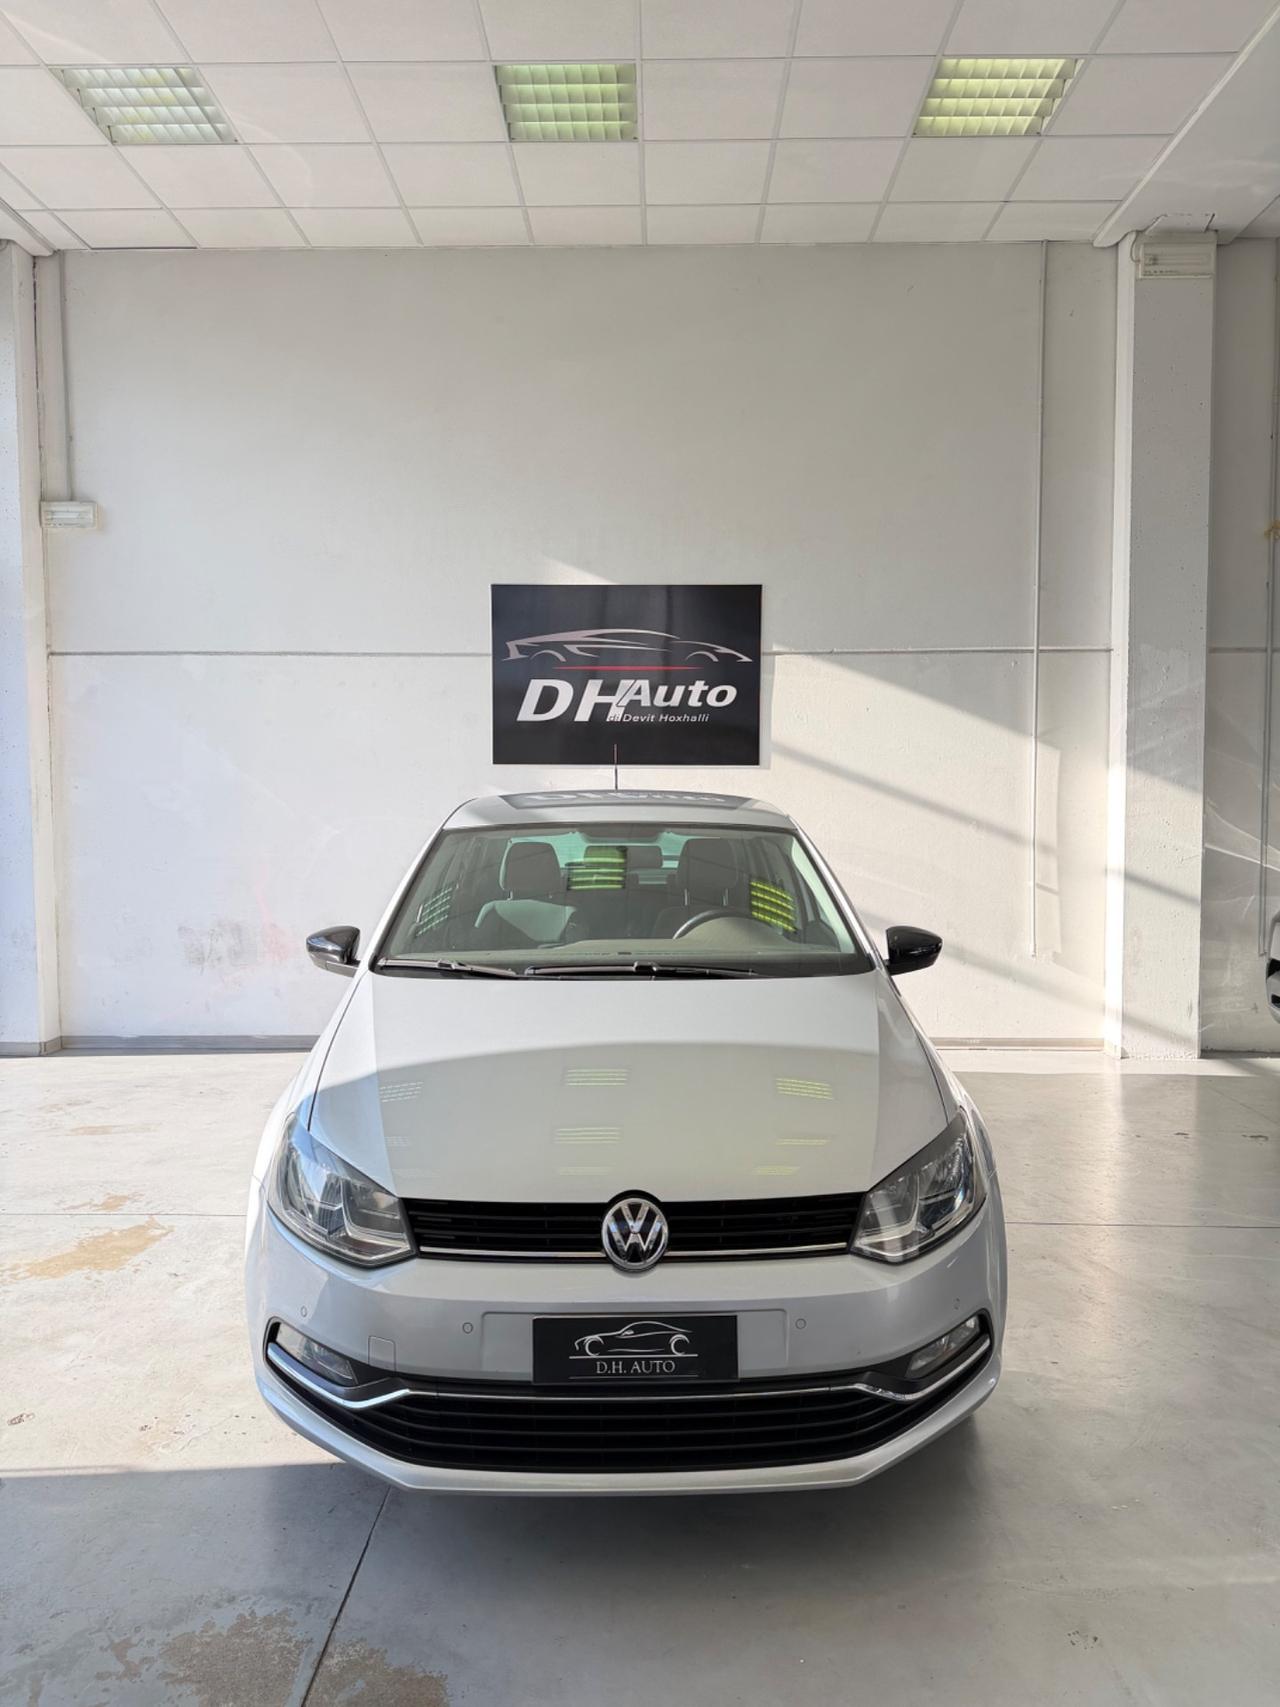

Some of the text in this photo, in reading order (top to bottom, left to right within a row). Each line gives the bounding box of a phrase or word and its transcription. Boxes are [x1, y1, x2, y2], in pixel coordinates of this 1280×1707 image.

[617, 679, 738, 707] Auto
[622, 713, 656, 722] Devit
[658, 713, 710, 722] Hoxhalli
[596, 1359, 676, 1374] D.H. AUTO
